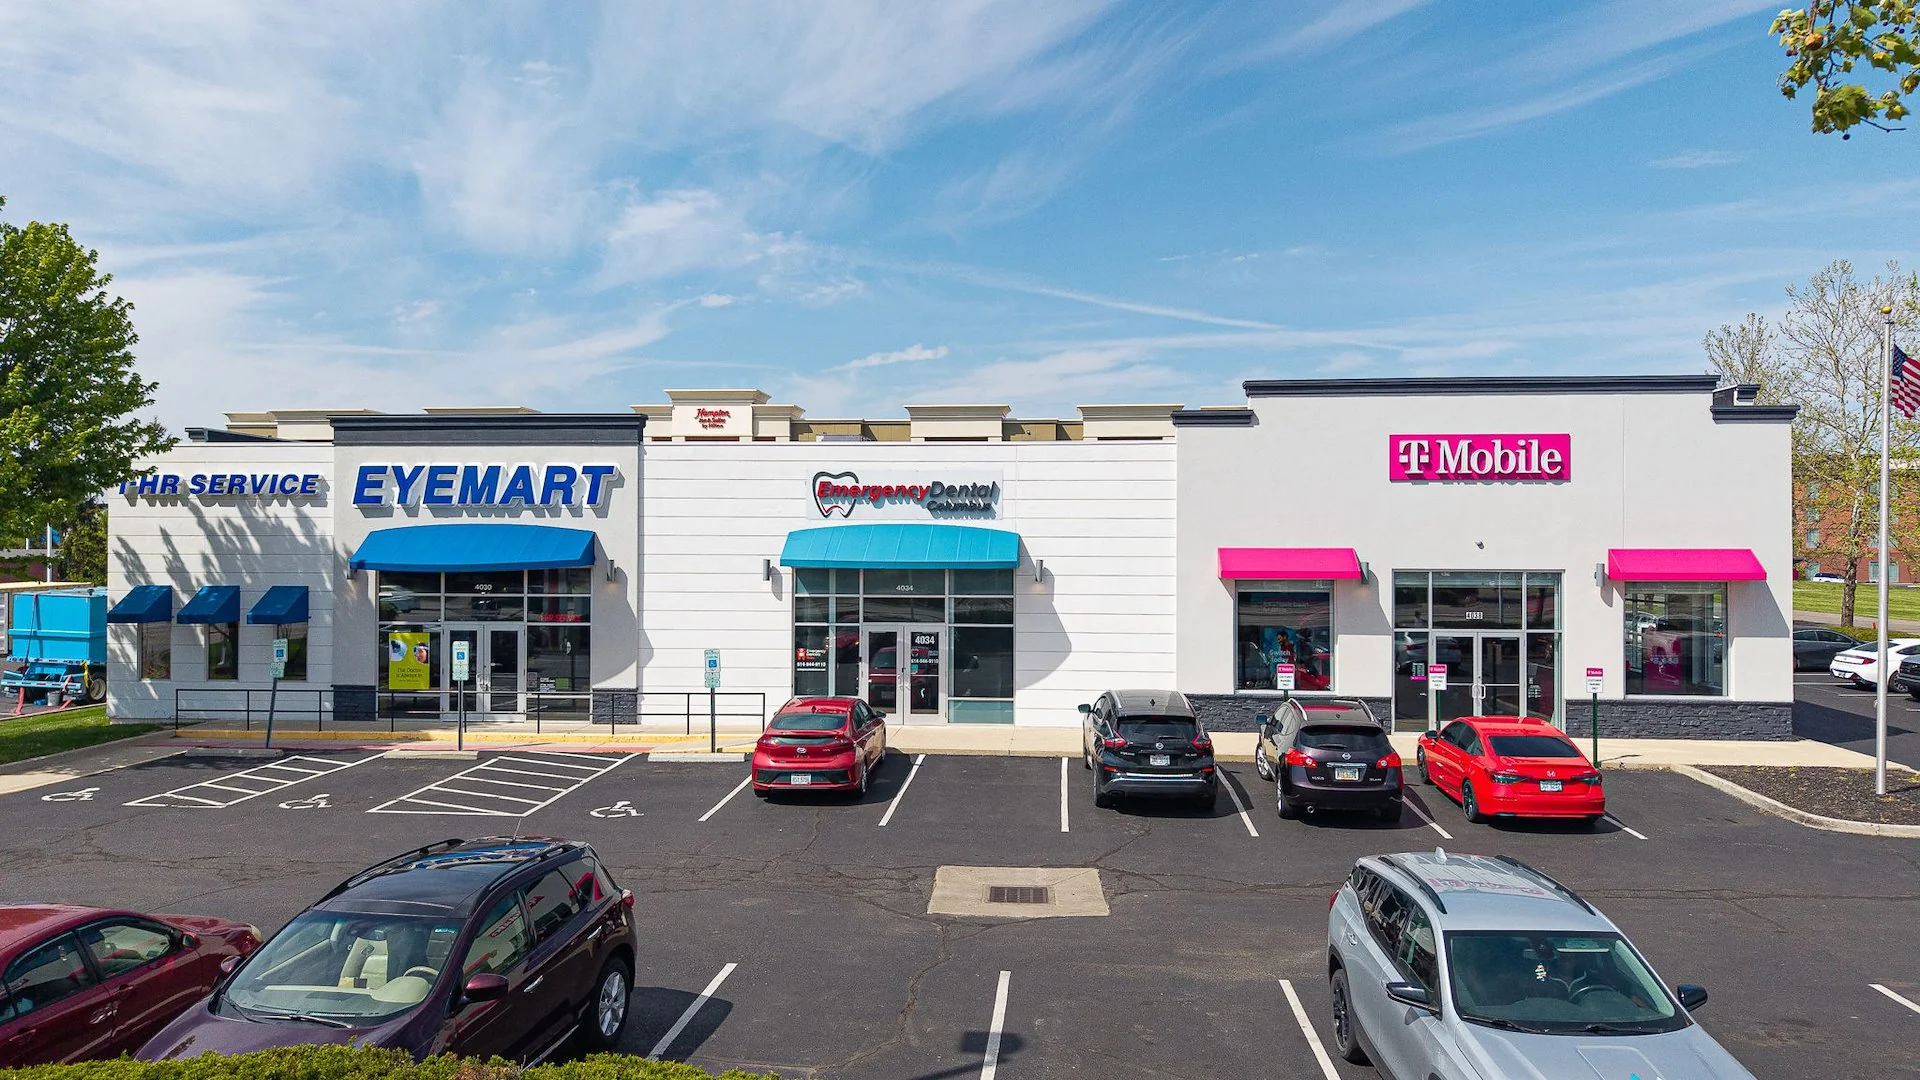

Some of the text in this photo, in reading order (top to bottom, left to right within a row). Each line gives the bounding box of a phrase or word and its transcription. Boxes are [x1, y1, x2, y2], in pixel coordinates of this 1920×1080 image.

[694, 408, 731, 419] Hampton
[1436, 439, 1562, 474] Mobile
[189, 474, 320, 495] SERVICE
[352, 465, 615, 505] EYEMART
[926, 500, 992, 512] Columbus
[474, 583, 493, 591] 4030
[896, 584, 914, 592] 4034
[914, 635, 936, 645] 4034
